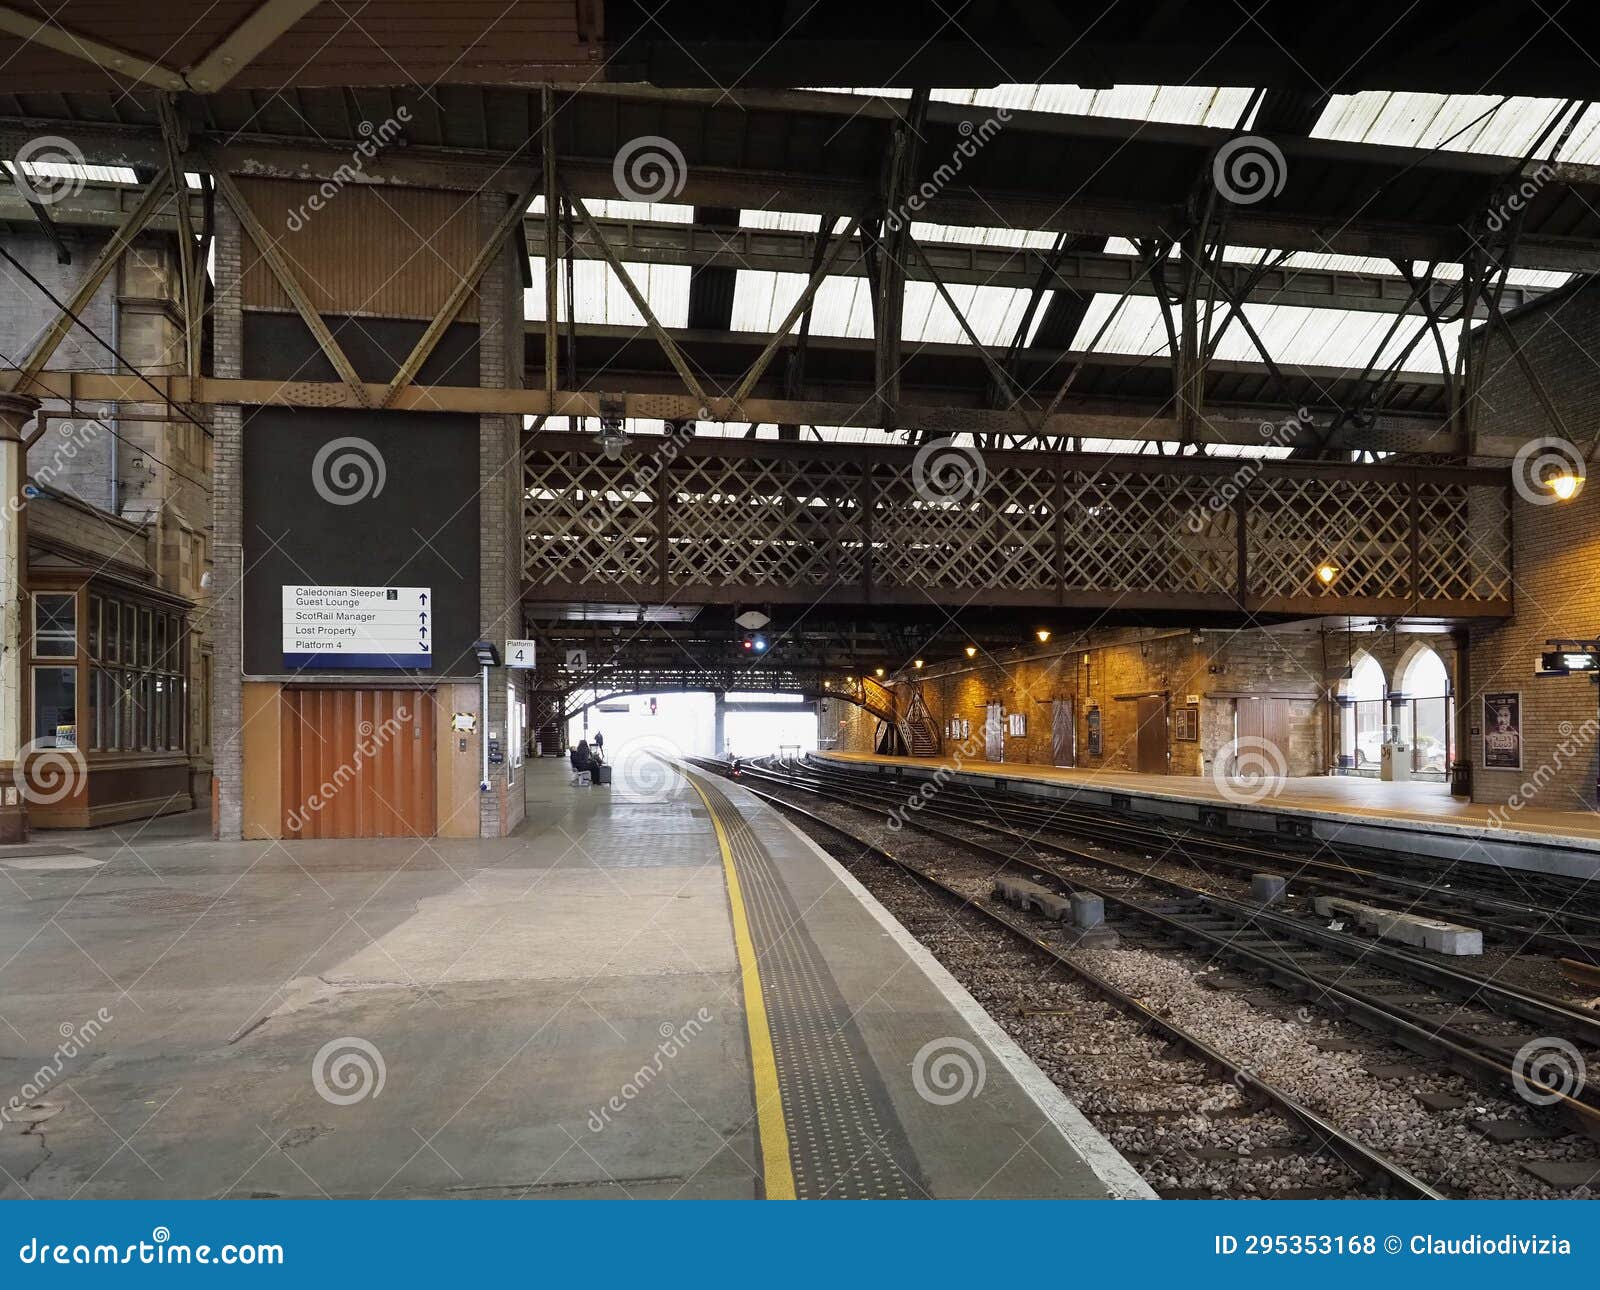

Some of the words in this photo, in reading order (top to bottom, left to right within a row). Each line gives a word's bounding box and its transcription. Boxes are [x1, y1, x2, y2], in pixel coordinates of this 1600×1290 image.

[295, 588, 348, 597] Caledonian
[350, 588, 385, 599] Sleeper
[295, 598, 323, 606] Guest
[326, 598, 360, 608] Lounge
[295, 612, 334, 620] ScotRail
[336, 612, 376, 622] Manager
[295, 626, 315, 634] Lost
[317, 626, 357, 636] Property
[295, 640, 334, 649] Platform
[336, 641, 342, 649] 4
[515, 649, 525, 662] 4
[570, 653, 583, 668] 4
